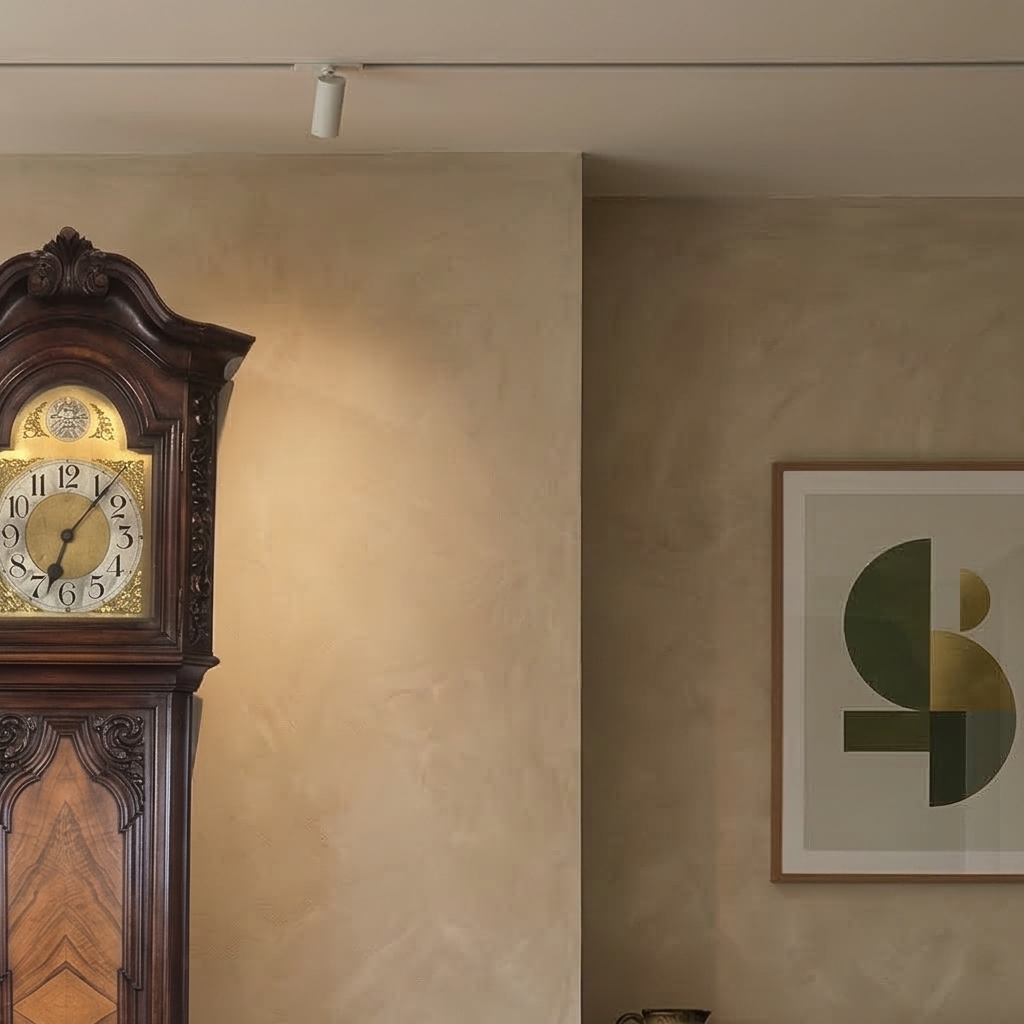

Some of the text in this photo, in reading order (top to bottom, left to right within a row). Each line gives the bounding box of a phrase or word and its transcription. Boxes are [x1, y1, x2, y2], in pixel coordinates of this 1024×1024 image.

[32, 474, 45, 496] 11
[58, 465, 80, 488] 12
[95, 475, 100, 497] 1
[9, 495, 29, 518] 10
[110, 495, 127, 519] 2
[2, 524, 19, 548] 9
[116, 525, 133, 549] 3
[9, 554, 26, 578] 8
[107, 554, 124, 577] 4
[30, 575, 46, 598] 7
[59, 582, 75, 606] 6
[88, 575, 104, 599] 5
